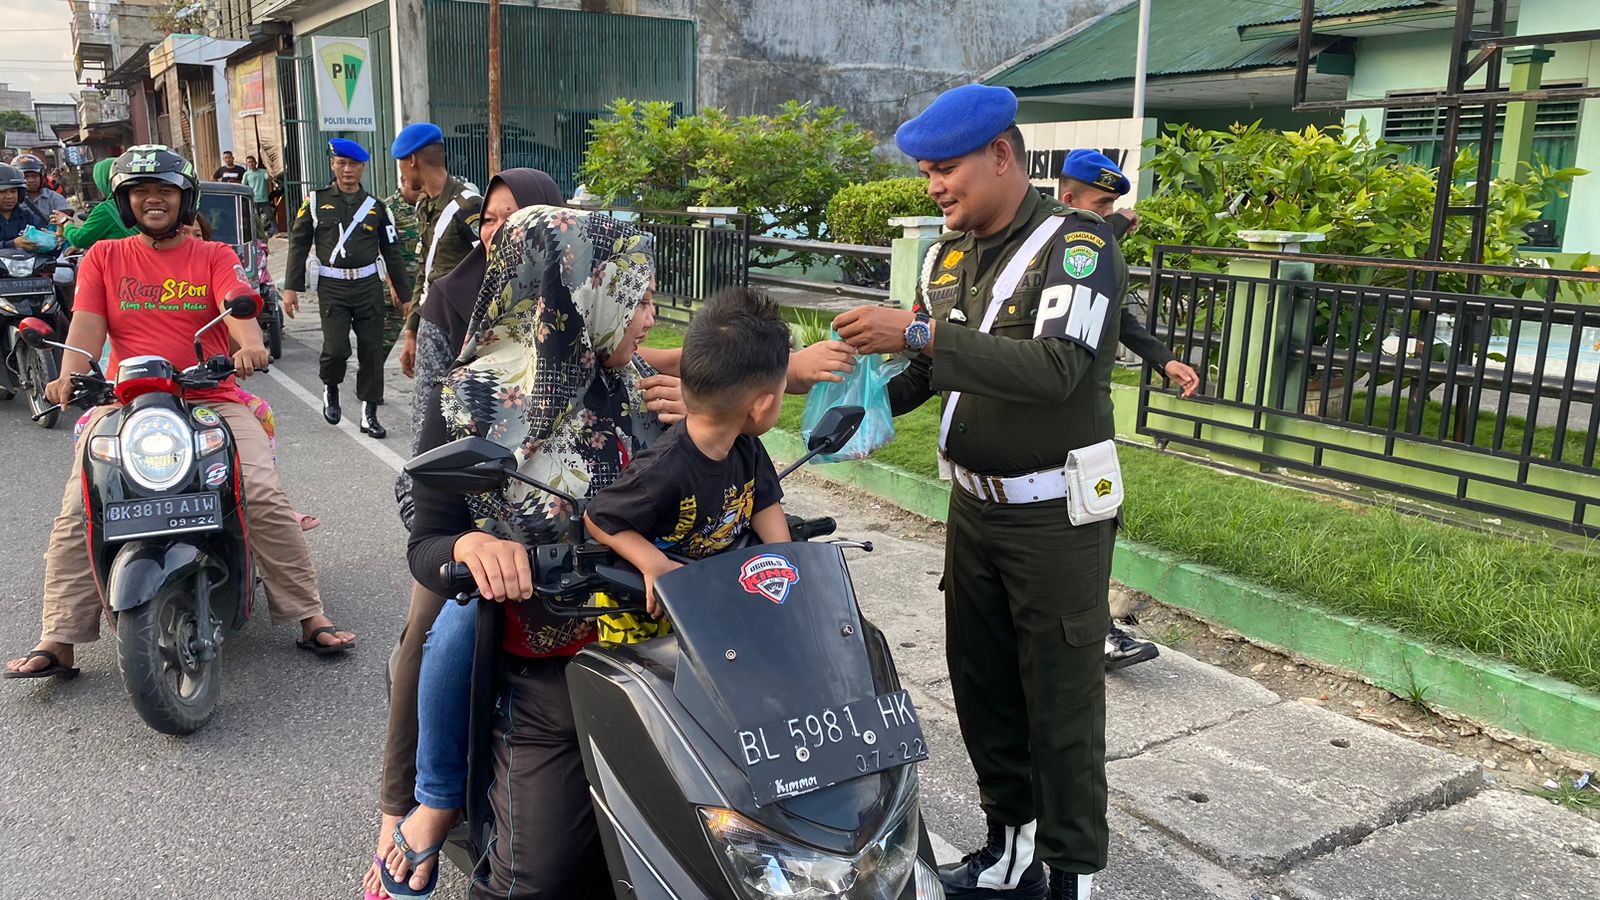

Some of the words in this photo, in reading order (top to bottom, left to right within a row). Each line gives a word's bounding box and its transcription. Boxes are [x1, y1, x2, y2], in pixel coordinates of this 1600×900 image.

[332, 63, 357, 80] PM
[324, 117, 346, 125] POLISI
[346, 117, 373, 126] MILITER
[1066, 232, 1096, 241] POMDAM
[1032, 283, 1110, 350] PM
[744, 569, 797, 592] KING
[739, 728, 780, 766] BL
[787, 705, 862, 749] 5981
[877, 692, 915, 729] HK
